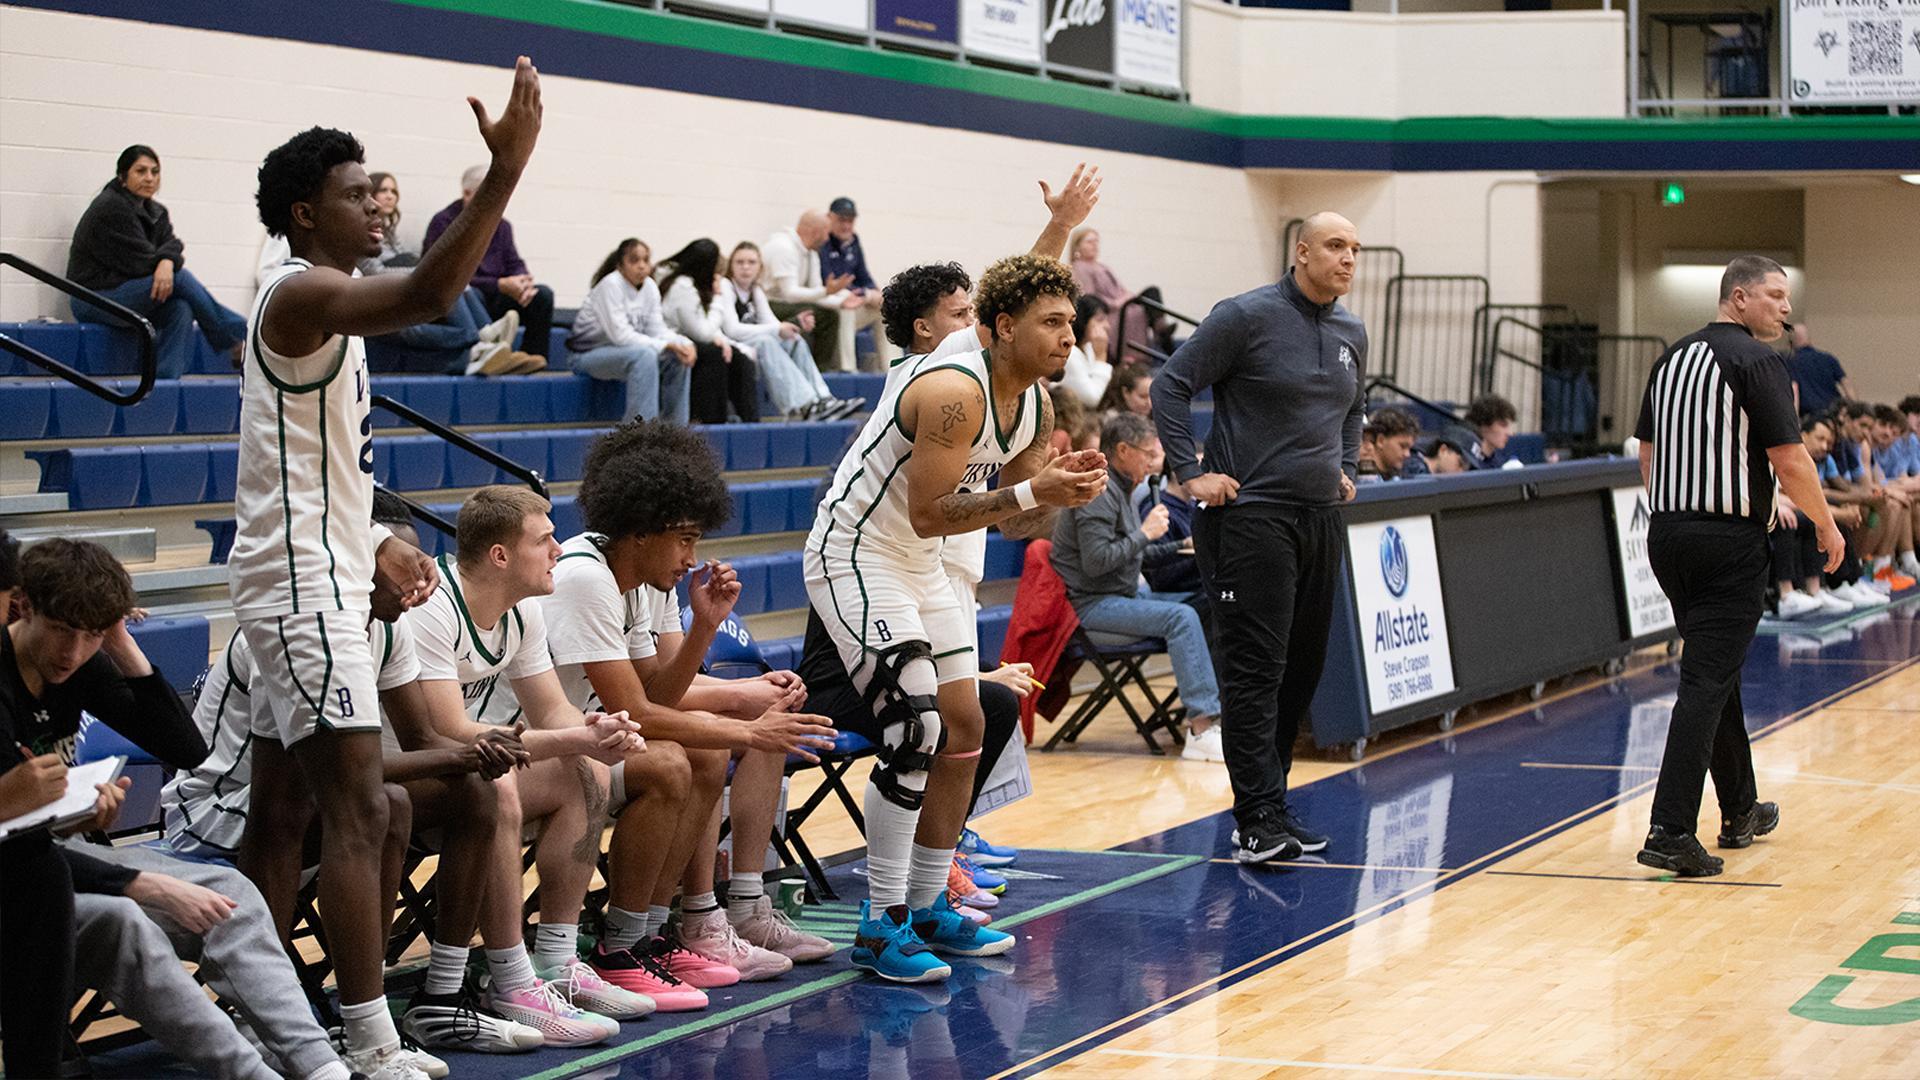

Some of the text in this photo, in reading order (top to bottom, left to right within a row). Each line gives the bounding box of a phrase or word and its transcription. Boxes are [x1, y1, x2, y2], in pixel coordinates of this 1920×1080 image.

[873, 619, 893, 643] B
[1374, 604, 1430, 653] Allstate
[1383, 660, 1403, 679] Steve
[335, 686, 355, 718] B
